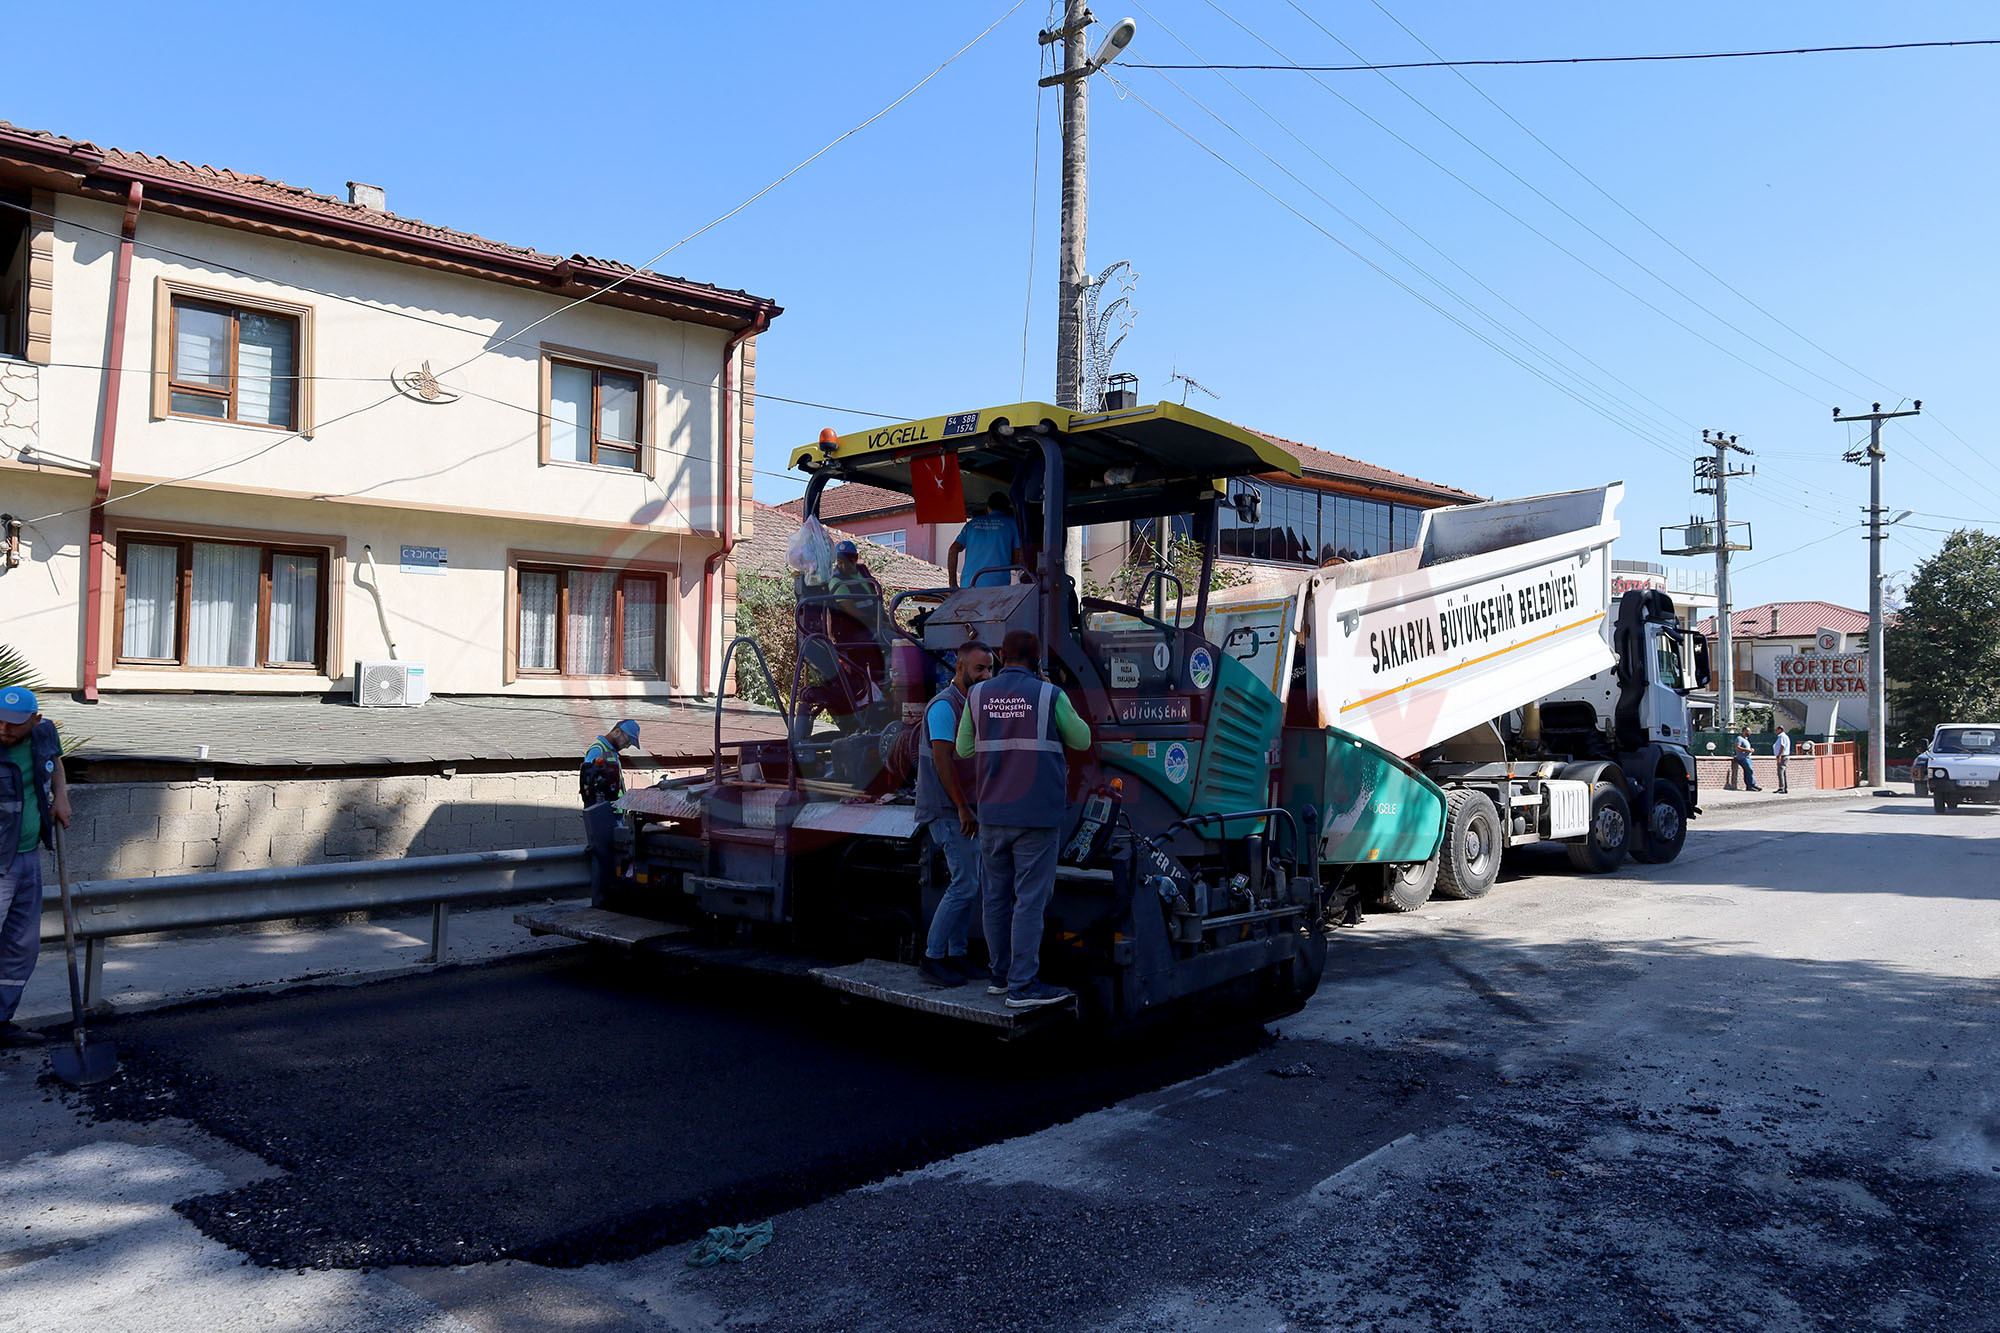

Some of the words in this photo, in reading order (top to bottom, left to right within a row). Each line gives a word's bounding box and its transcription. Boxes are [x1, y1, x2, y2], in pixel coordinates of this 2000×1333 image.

[948, 417, 957, 426] 54
[962, 414, 977, 424] SBB
[956, 424, 974, 433] 1574
[1370, 617, 1435, 674] SAKARYA
[1438, 583, 1516, 651] BÜYÜKŞEHİR
[1518, 564, 1579, 625] BELEDİYESİ
[1157, 646, 1164, 667] 1
[1780, 656, 1863, 675] KÖFTECİ
[1777, 678, 1818, 693] ETEM
[1823, 678, 1866, 692] USTA
[982, 703, 1033, 711] BÜYÜKŞEHİR
[1122, 701, 1188, 720] BÜYÜKŞEHİR
